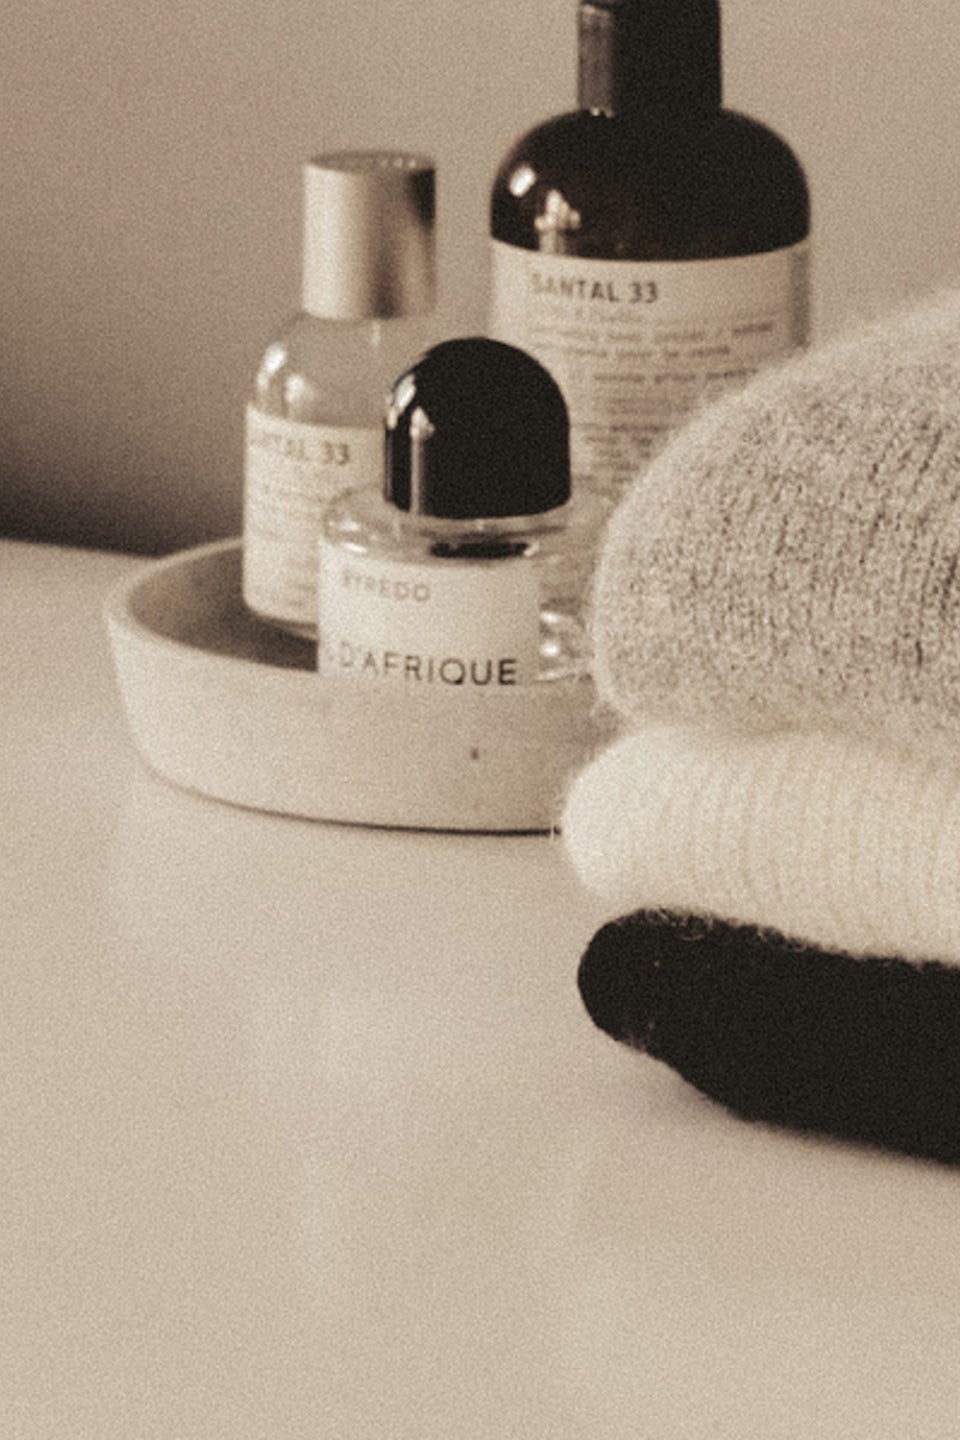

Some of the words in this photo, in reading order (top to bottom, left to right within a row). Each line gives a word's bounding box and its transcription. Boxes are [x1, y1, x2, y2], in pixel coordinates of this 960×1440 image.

[532, 272, 619, 303] SANTAL
[627, 281, 659, 304] 33
[318, 440, 350, 466] 33
